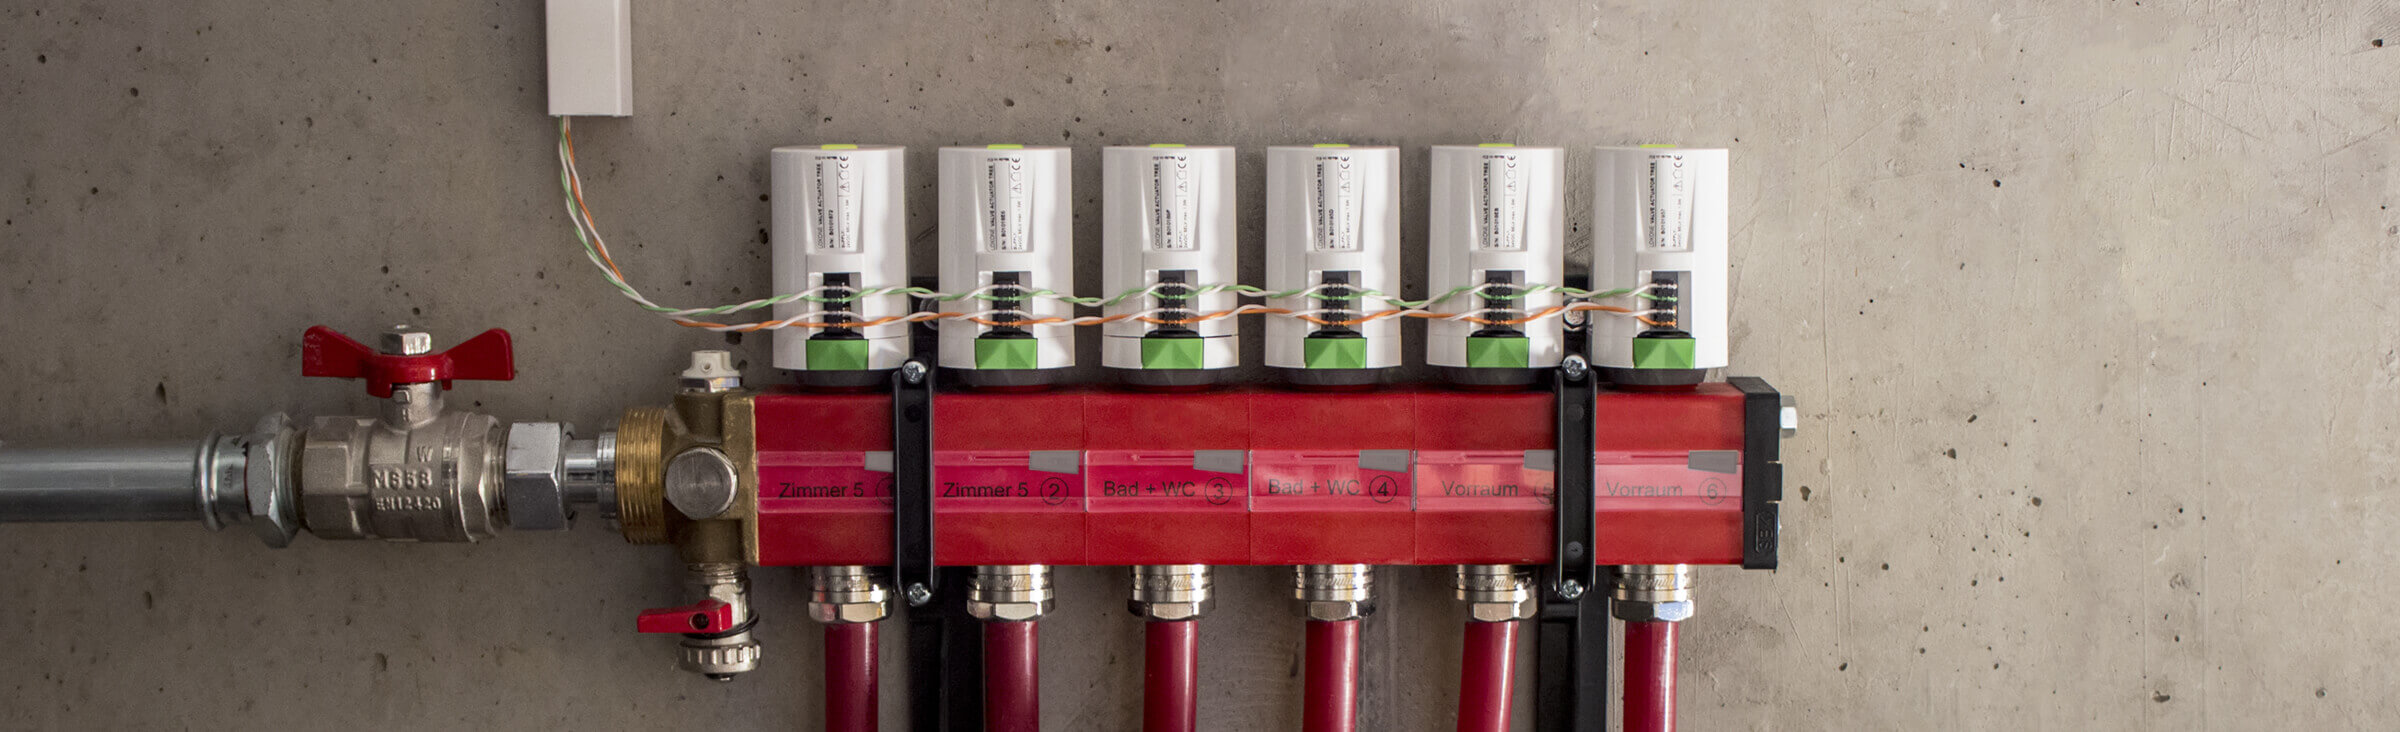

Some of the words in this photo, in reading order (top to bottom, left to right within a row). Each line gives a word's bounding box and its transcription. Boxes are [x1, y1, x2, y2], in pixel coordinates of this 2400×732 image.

[417, 445, 433, 463] W
[779, 482, 848, 499] Zimmer
[853, 482, 864, 498] 5
[943, 482, 1012, 498] Zimmer
[1017, 482, 1029, 498] 5
[1104, 480, 1139, 497] Bad
[1145, 483, 1156, 494] +
[1161, 481, 1195, 497] WC
[1268, 478, 1303, 495] Bad
[1310, 481, 1321, 493] +
[1326, 479, 1360, 496] WC
[1442, 480, 1518, 497] Vorraum
[1606, 481, 1683, 497] Vorraum
